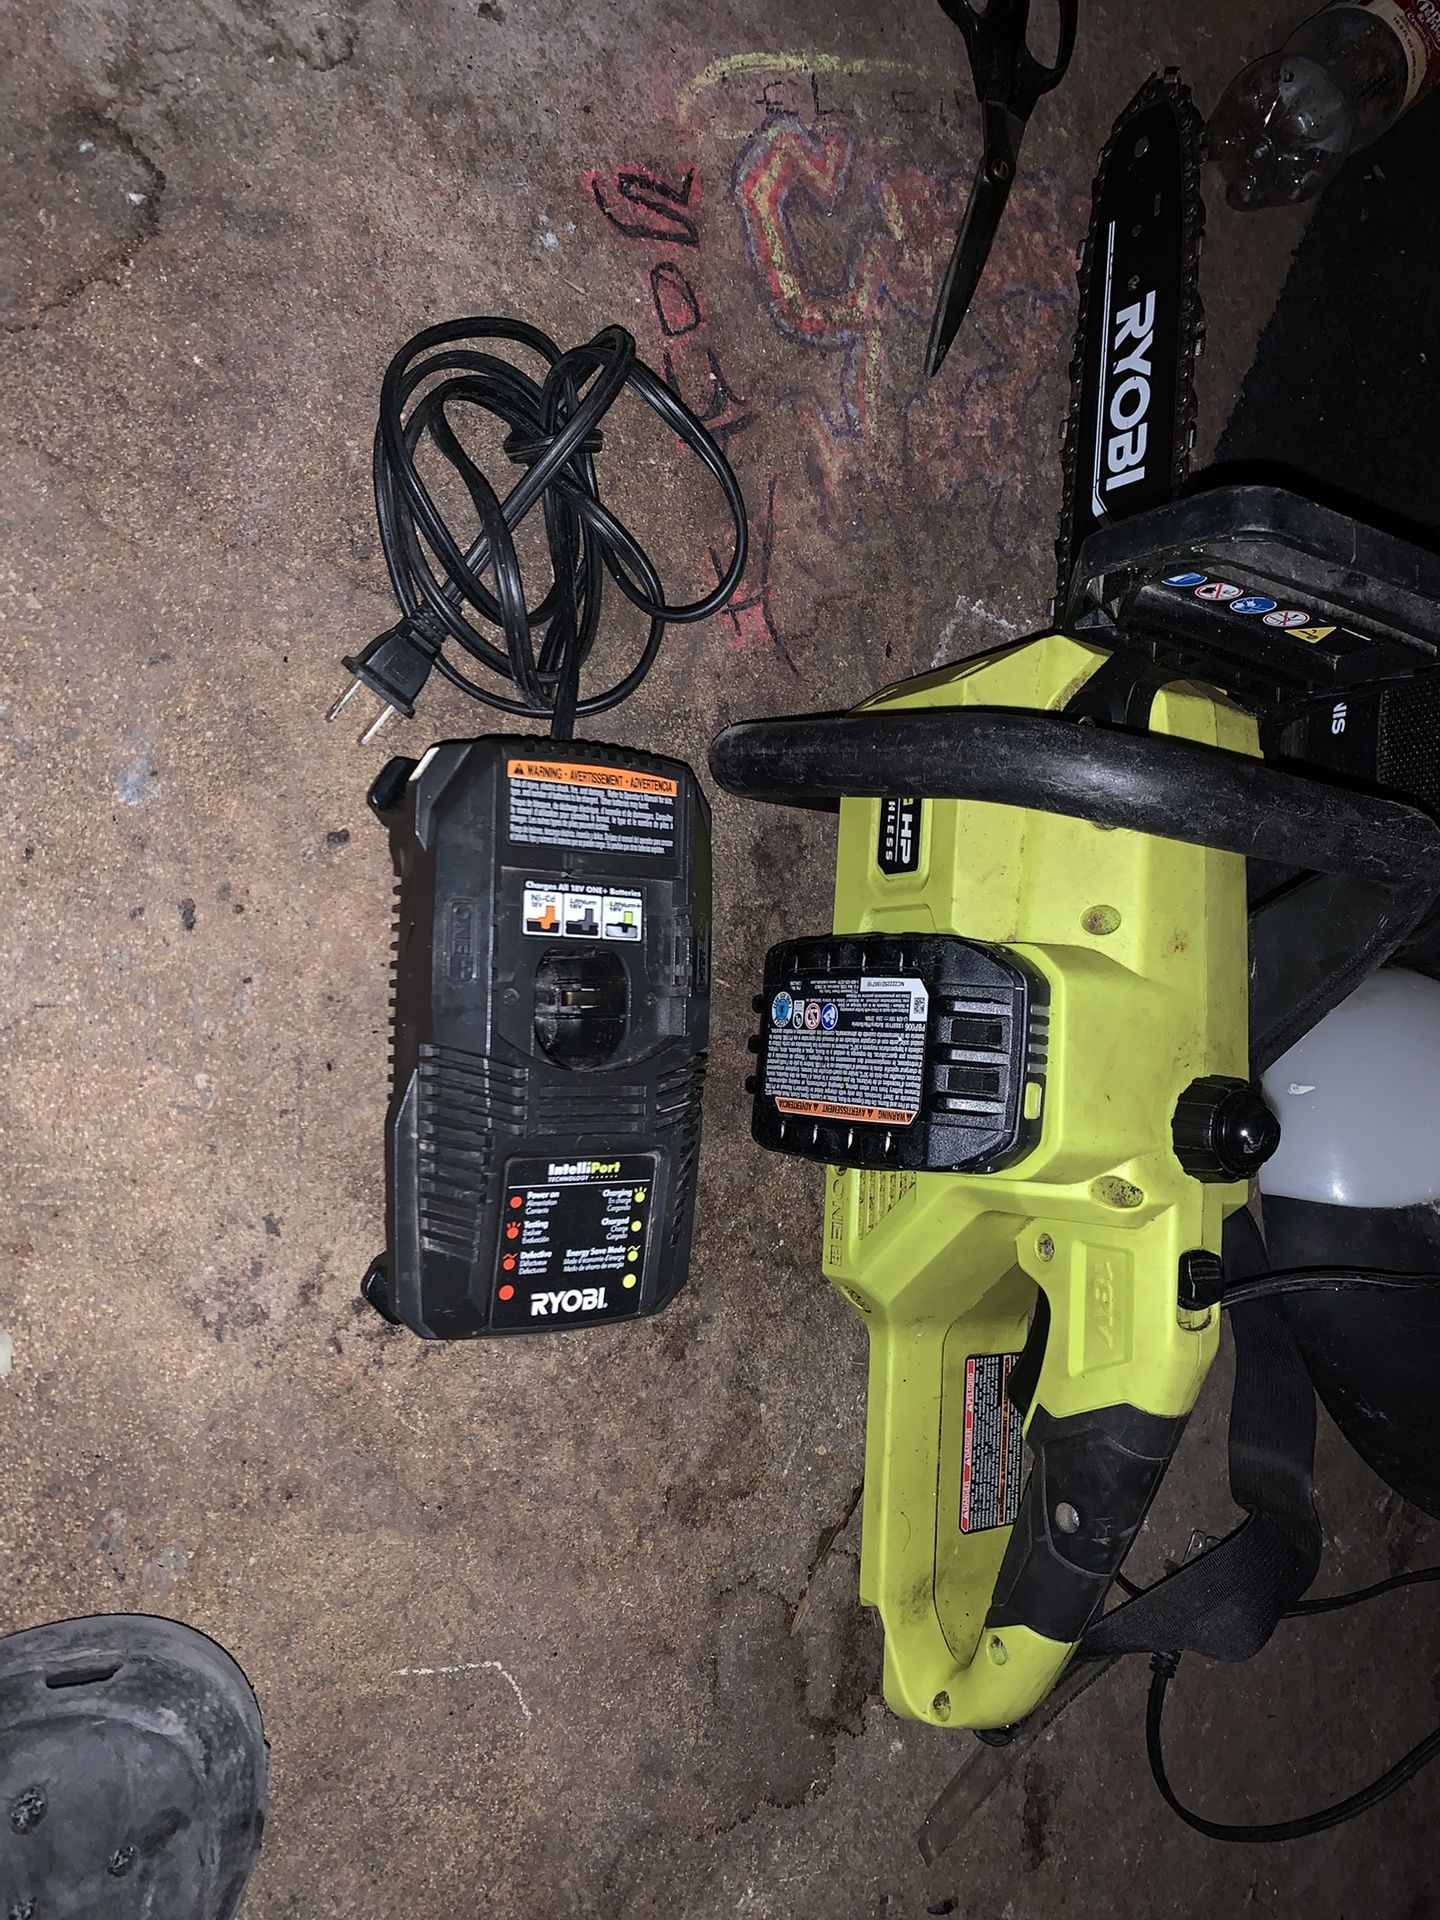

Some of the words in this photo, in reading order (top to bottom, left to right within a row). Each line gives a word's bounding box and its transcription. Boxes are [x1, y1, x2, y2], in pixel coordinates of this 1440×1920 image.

[1106, 290, 1156, 492] RYOBI
[527, 765, 563, 778] WARNING
[570, 771, 623, 787] AVERTISSEMENT
[630, 778, 673, 793] ADVERTENCIA
[900, 813, 913, 864] HP
[525, 880, 557, 891] Charges
[558, 883, 569, 891] All
[609, 888, 641, 897] Batteries
[531, 894, 555, 903] Ni-Cd
[905, 1023, 925, 1031] PBP006
[778, 1100, 812, 1111] ADVERTENCIA
[822, 1104, 866, 1117] AVERTISSEMENT
[878, 1110, 905, 1121] WARNING
[548, 1161, 621, 1176] IntelliPort
[602, 1189, 633, 1198] Charging
[523, 1221, 549, 1230] Testing
[601, 1217, 630, 1226] Charged
[520, 1251, 553, 1259] Defective
[566, 1248, 590, 1259] Energy
[607, 1246, 626, 1254] Mode
